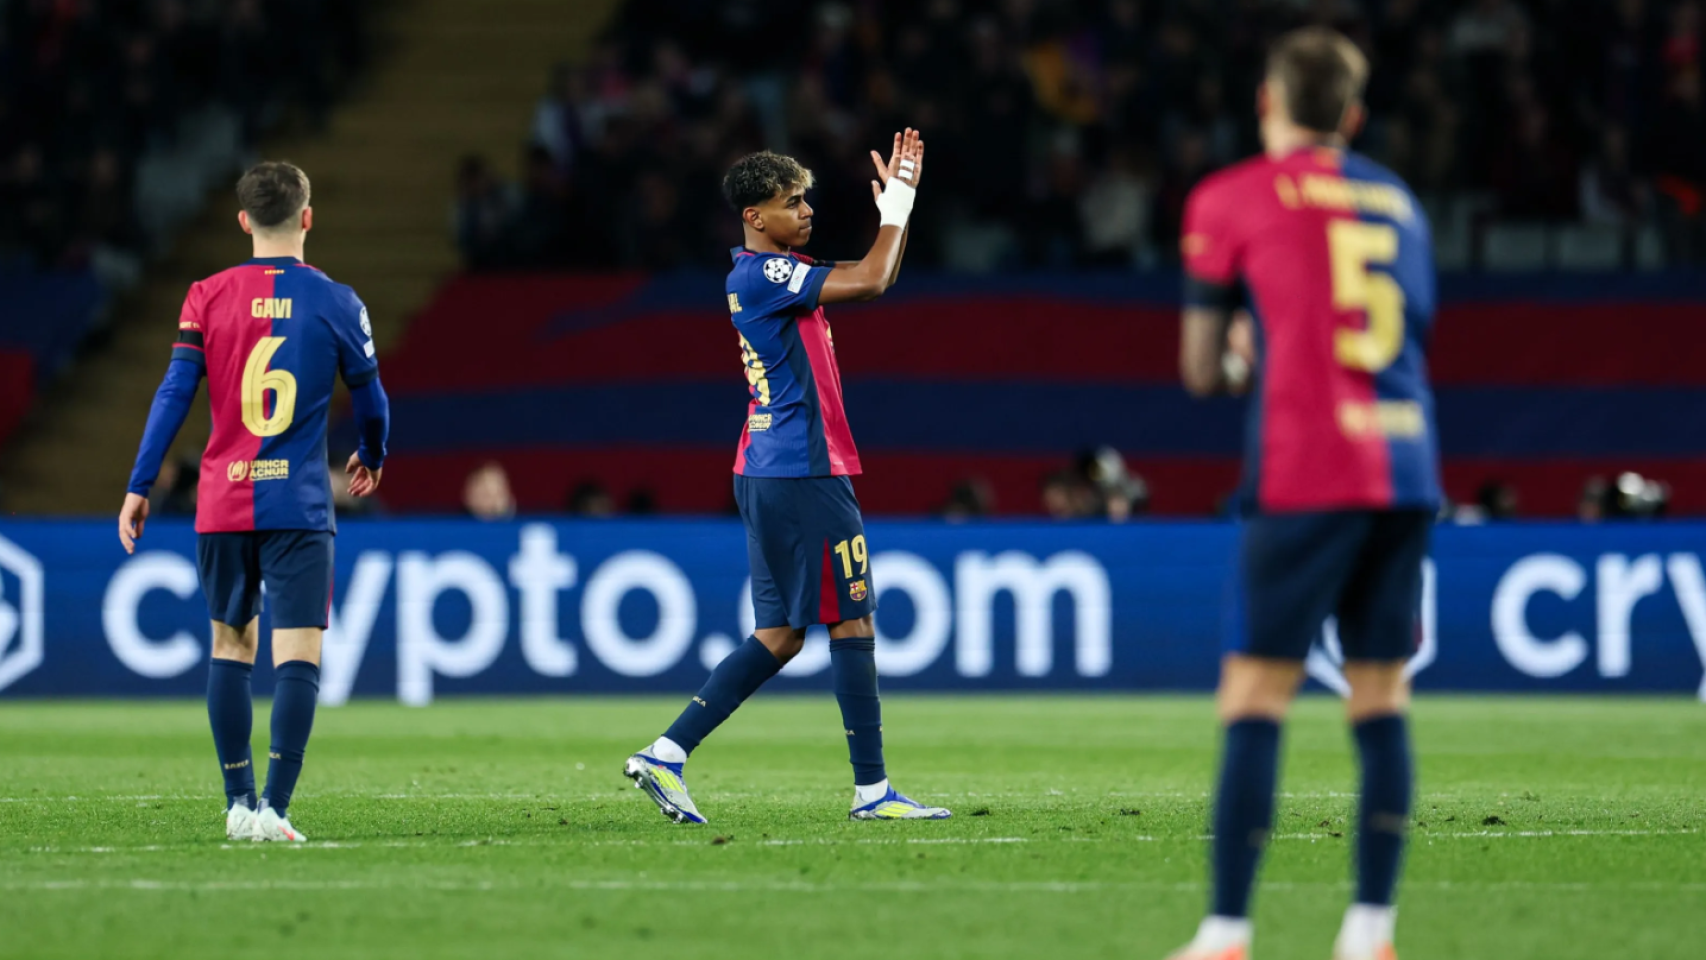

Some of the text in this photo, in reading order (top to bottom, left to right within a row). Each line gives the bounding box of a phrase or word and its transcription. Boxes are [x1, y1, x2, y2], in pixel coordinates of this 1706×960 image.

[251, 298, 292, 319] GAVI
[1326, 216, 1406, 374] 5
[241, 336, 297, 437] 6
[250, 459, 289, 468] UNHCR
[834, 534, 868, 579] 19
[101, 522, 1113, 706] cypto.om
